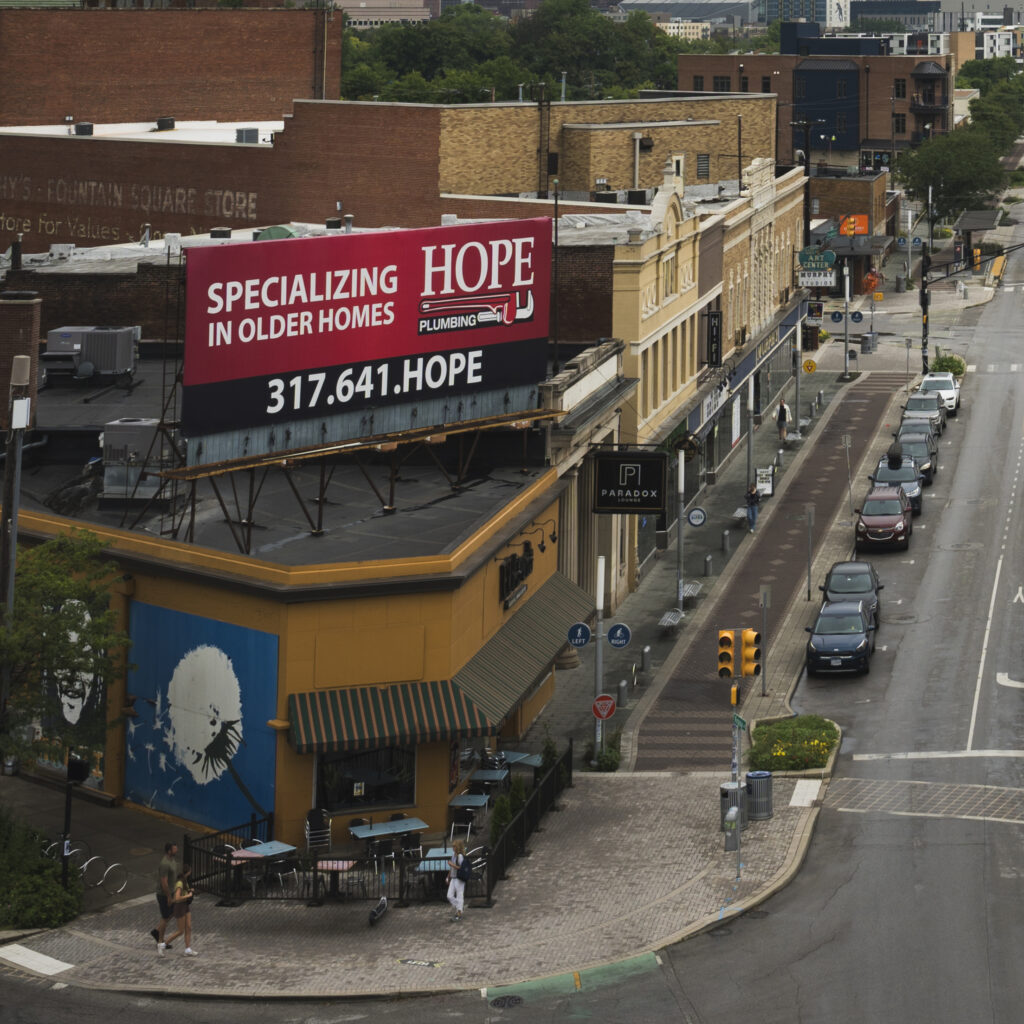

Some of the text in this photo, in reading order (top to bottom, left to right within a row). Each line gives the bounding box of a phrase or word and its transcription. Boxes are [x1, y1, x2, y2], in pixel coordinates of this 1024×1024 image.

[47, 178, 123, 208] FOUNTAIN
[130, 184, 196, 215] SQUARE
[204, 189, 258, 220] STORE
[420, 236, 535, 297] HOPE
[800, 270, 833, 278] MURPHY
[207, 264, 398, 314] SPECIALIZING
[208, 301, 395, 347] IN OLDER HOMES
[419, 314, 477, 332] PLUMBING
[266, 349, 483, 414] 317.641.HOPE
[601, 489, 658, 498] PARADOX
